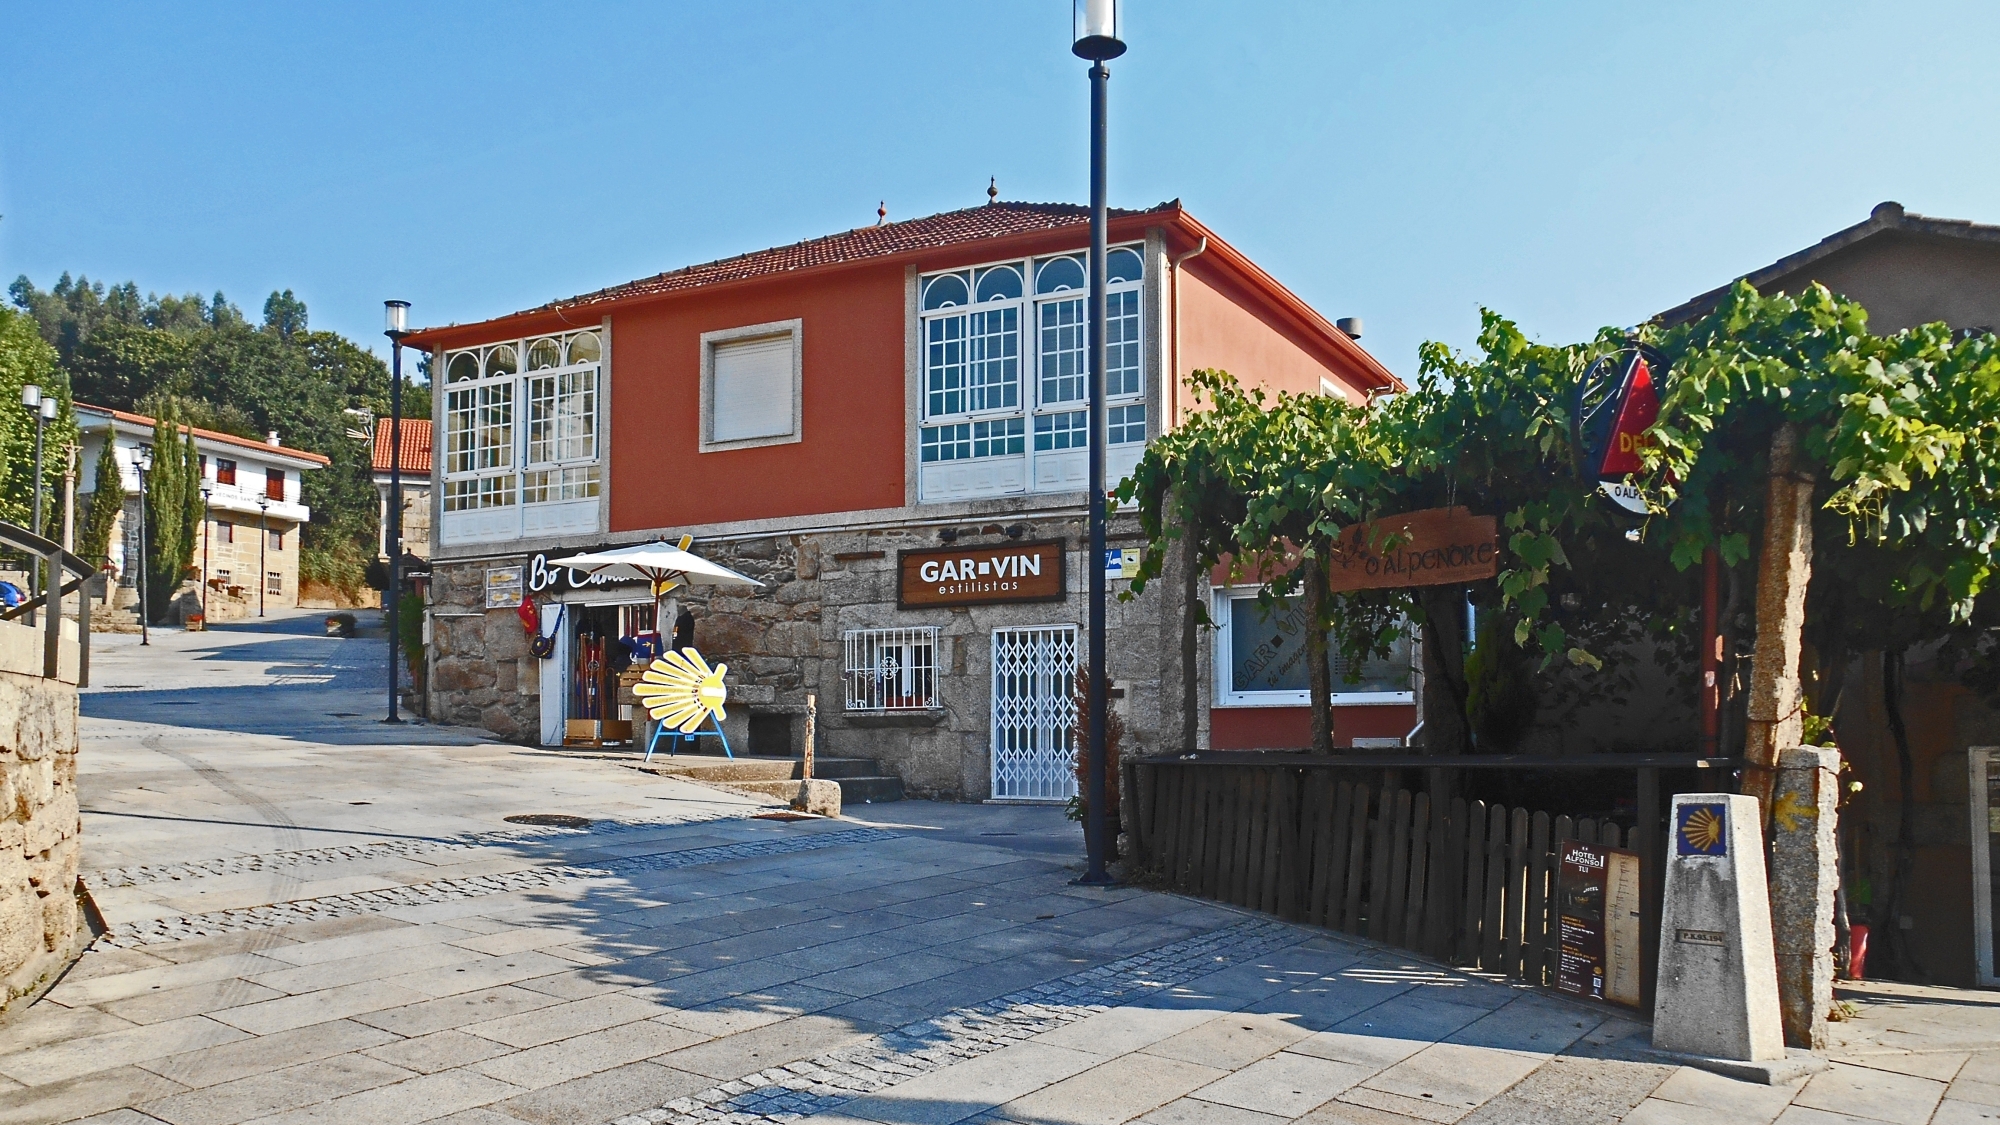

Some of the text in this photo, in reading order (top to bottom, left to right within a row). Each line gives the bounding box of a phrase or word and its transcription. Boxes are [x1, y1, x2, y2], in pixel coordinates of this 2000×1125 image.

[1614, 486, 1622, 497] O
[528, 553, 561, 592] Bo
[1365, 555, 1379, 576] O
[938, 580, 1019, 595] estilistas
[1565, 853, 1600, 867] ALFONSO
[1572, 849, 1596, 860] HOTEL
